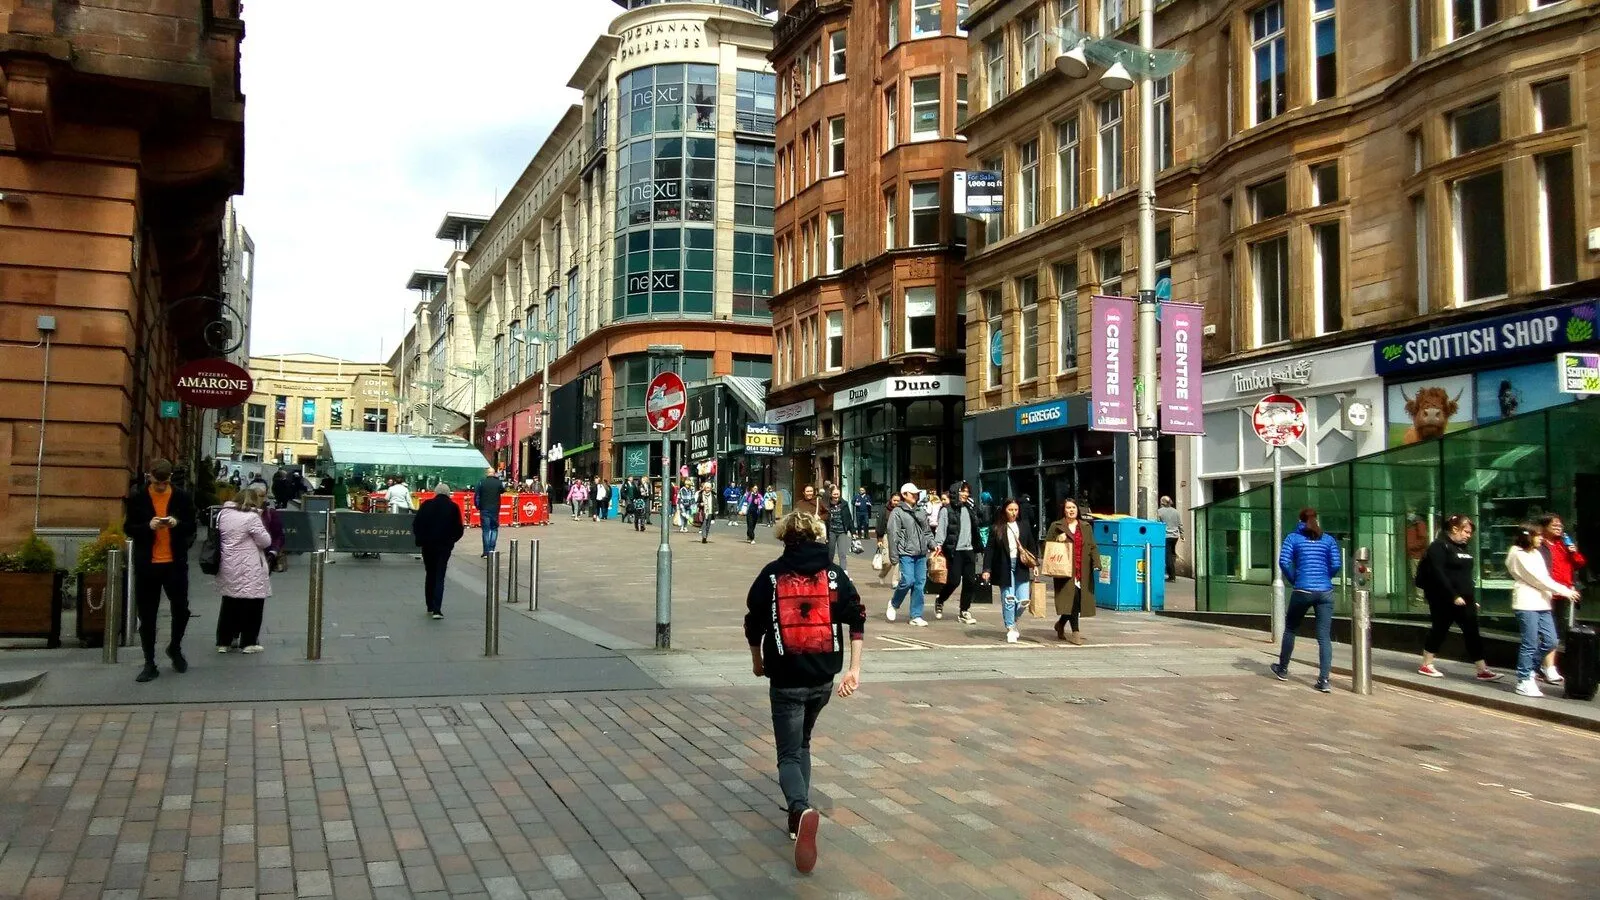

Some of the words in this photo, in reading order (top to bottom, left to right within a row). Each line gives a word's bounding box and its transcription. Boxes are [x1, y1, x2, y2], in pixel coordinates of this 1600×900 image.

[620, 22, 701, 47] BUCHANAN
[621, 38, 700, 59] GALLERIES
[634, 87, 678, 107] next
[632, 182, 677, 201] next
[630, 273, 674, 291] next
[1405, 326, 1496, 365] SCOTTISH
[1502, 316, 1559, 349] SHOP
[1106, 325, 1120, 396] CENTRE
[1175, 329, 1189, 400] CENTRE
[177, 376, 248, 390] AMARONE
[895, 379, 941, 391] Dune
[1232, 364, 1293, 393] Timberland
[849, 388, 868, 400] Dune
[1029, 406, 1061, 423] GREGGS
[747, 436, 761, 444] TO
[764, 437, 783, 446] LET
